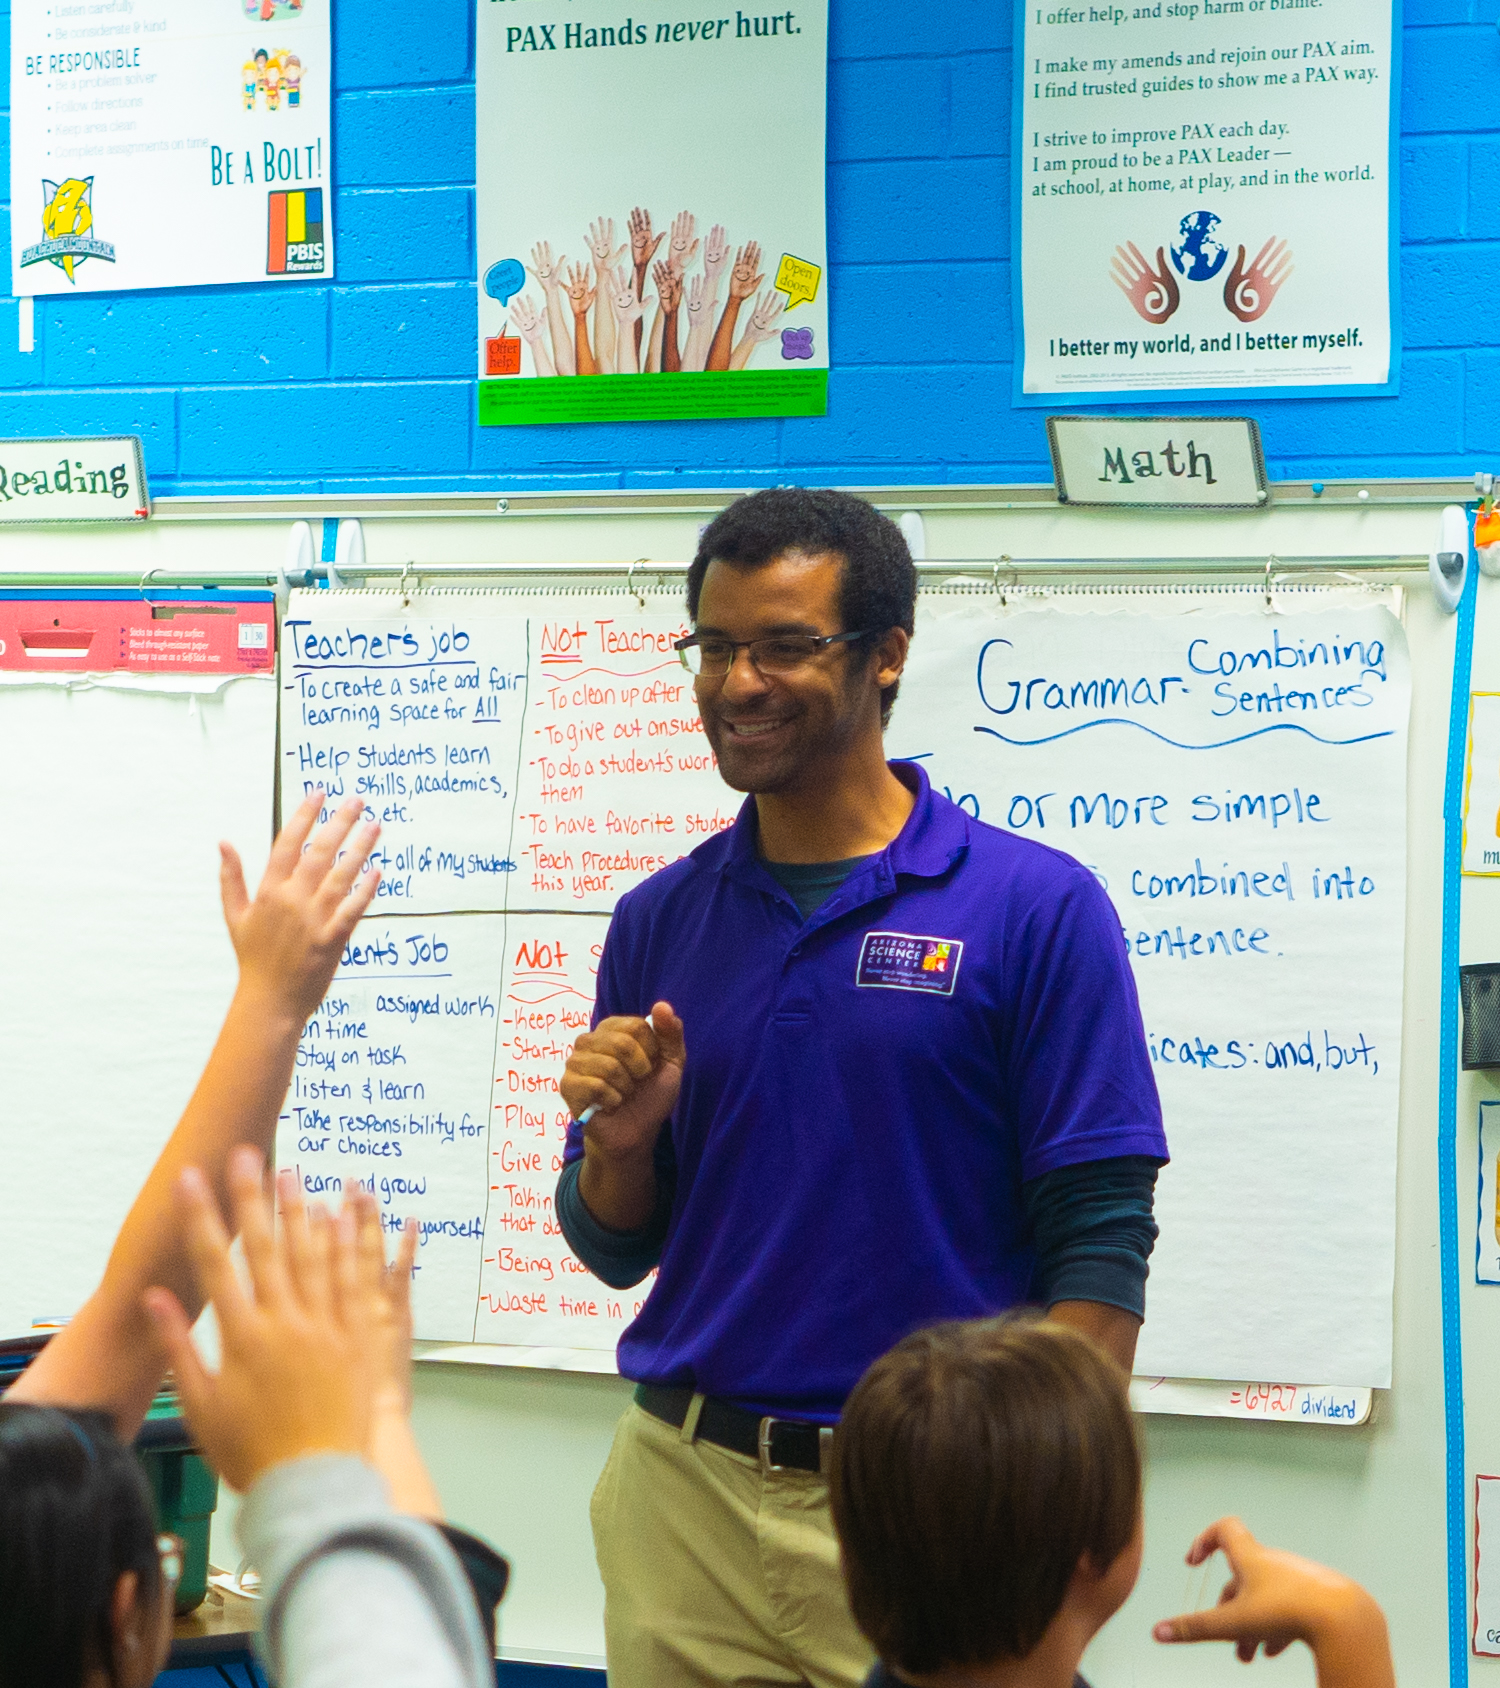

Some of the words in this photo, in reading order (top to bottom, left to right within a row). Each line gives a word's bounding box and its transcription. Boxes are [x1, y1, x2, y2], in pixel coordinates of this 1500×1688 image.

[506, 24, 556, 52] PAX
[564, 19, 647, 49] Hands
[655, 18, 729, 43] never
[735, 10, 802, 38] hurt.
[26, 56, 43, 75] BE
[50, 48, 141, 73] RESPONSIBLE
[1035, 59, 1040, 74] I
[1045, 56, 1088, 73] make
[1093, 56, 1117, 75] my
[1121, 52, 1183, 70] amends
[1187, 49, 1215, 66] and
[1221, 47, 1267, 67] rejoin
[1271, 46, 1298, 60] our
[1302, 41, 1336, 58] PAX
[1340, 41, 1375, 56] aim.
[286, 243, 323, 260] PBIS
[286, 260, 323, 271] Rewards
[1050, 340, 1054, 356] I
[1059, 336, 1111, 355] better
[1114, 338, 1138, 359] my
[1142, 335, 1194, 355] world,
[1200, 333, 1231, 352] and
[1236, 334, 1240, 351] I
[1246, 332, 1298, 350] better
[1302, 329, 1363, 353] myself.
[1098, 439, 1218, 485] Math
[285, 620, 419, 660] Teacher's
[428, 623, 470, 661] job
[1188, 630, 1387, 681] Combining
[302, 704, 380, 729] learning
[390, 701, 439, 726] space
[444, 698, 465, 720] for
[475, 696, 499, 718] All
[1211, 681, 1373, 716] Sentences
[1008, 792, 1059, 829] or
[1192, 789, 1331, 828] simple
[1132, 858, 1295, 901] combined
[1313, 867, 1375, 899] into
[869, 947, 921, 959] SCIENCE
[376, 995, 440, 1023] assigned
[445, 996, 495, 1019] work
[339, 1114, 455, 1145] responsibility
[459, 1113, 486, 1138] for
[1301, 1393, 1356, 1419] dividend
